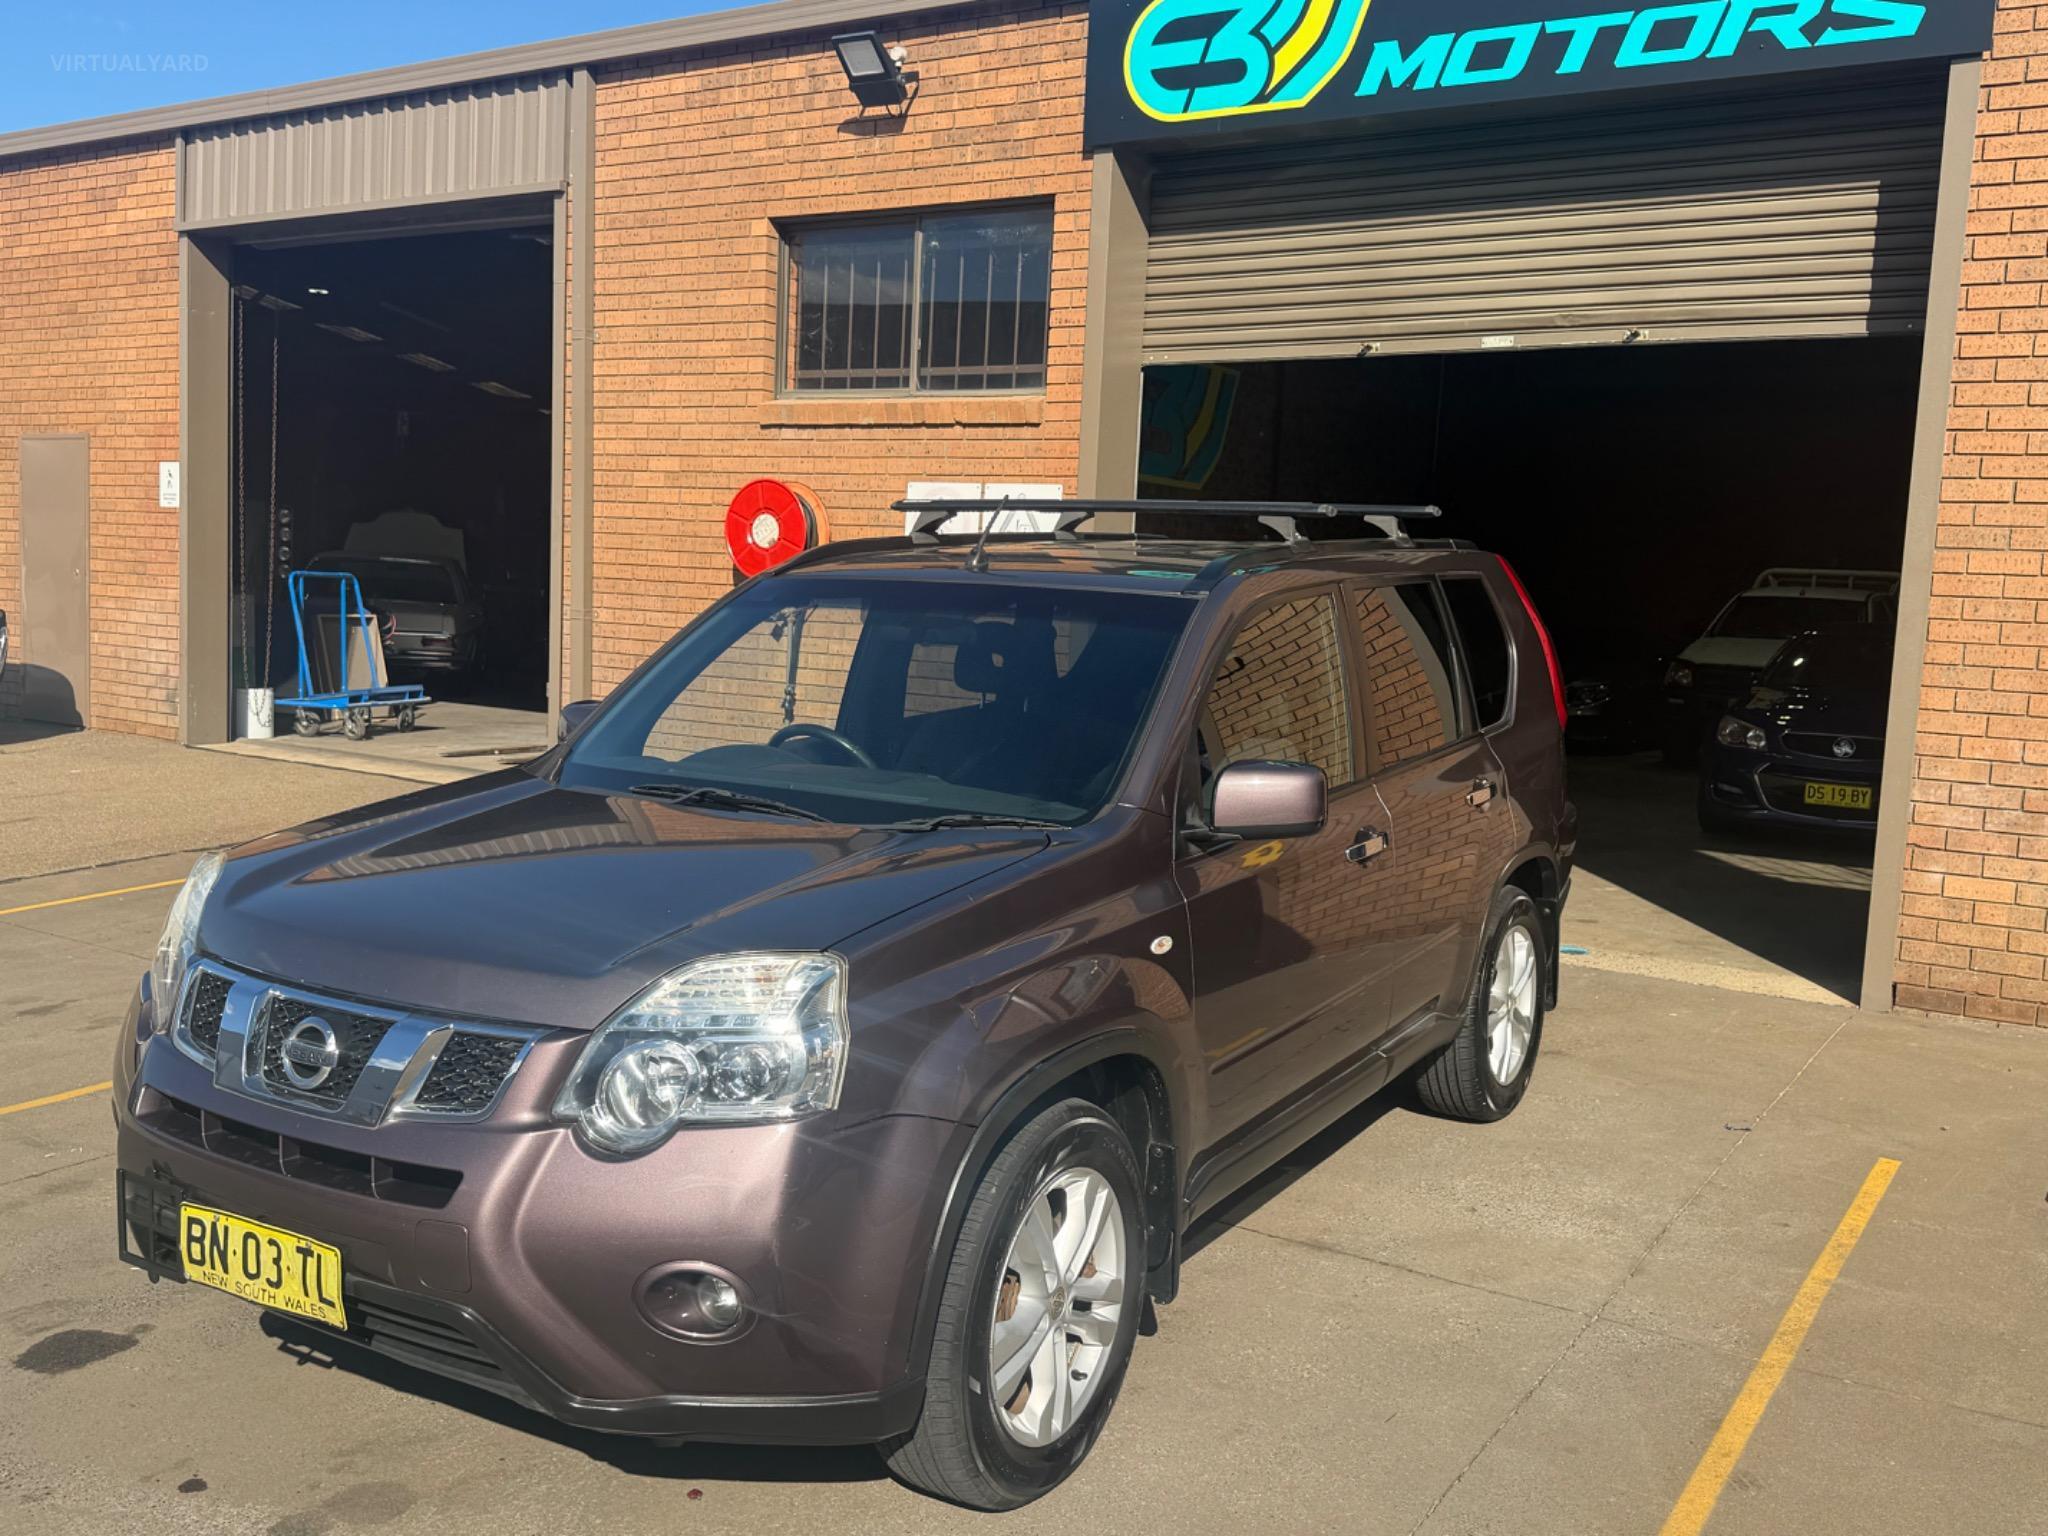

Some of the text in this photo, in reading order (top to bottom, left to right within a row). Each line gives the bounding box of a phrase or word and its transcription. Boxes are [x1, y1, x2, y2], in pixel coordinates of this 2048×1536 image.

[1353, 0, 1927, 97] MOTORS
[202, 1270, 327, 1319] NEW SOUTH WALES
